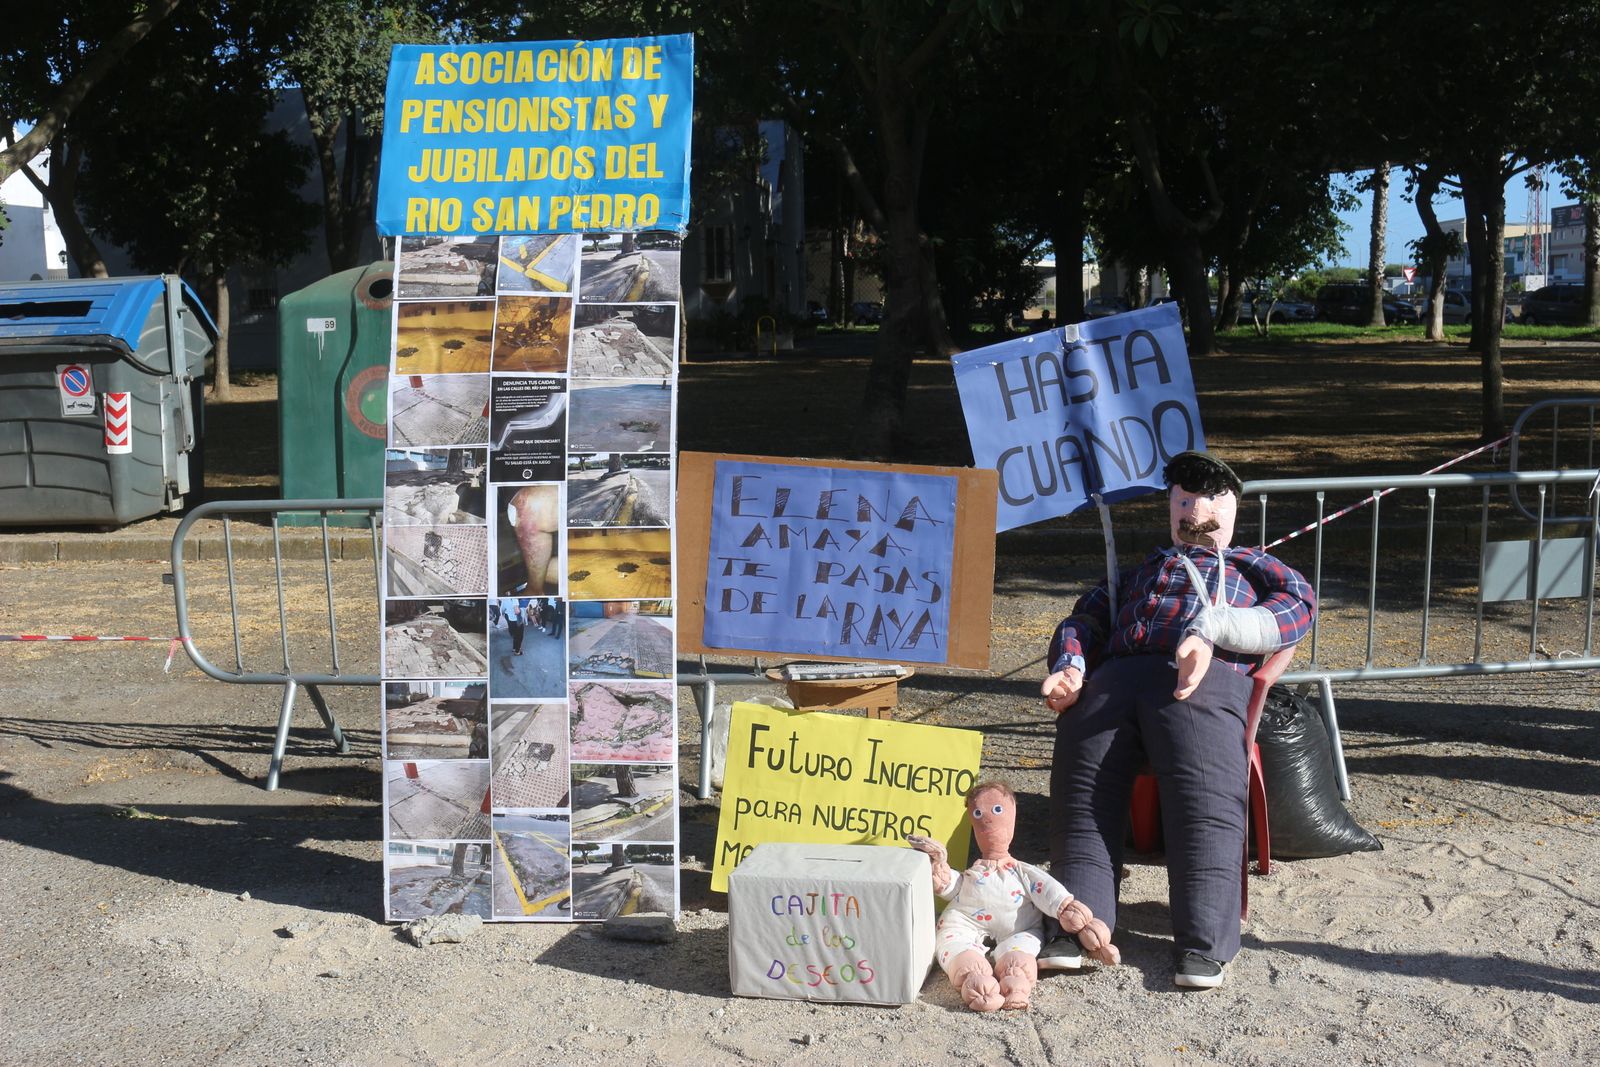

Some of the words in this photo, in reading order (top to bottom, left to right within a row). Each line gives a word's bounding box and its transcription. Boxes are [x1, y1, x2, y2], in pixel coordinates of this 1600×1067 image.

[414, 41, 612, 85] ASOCIACIÓN
[621, 45, 662, 81] DE
[399, 94, 637, 134] PENSIONISTAS
[648, 94, 669, 128] Y
[408, 145, 596, 183] JUBILADOS
[604, 142, 665, 180] DEL
[405, 197, 463, 233] RIO
[471, 195, 540, 232] SAN
[548, 193, 660, 230] PEDRO
[994, 329, 1172, 422] HASTA
[995, 400, 1195, 507] CUÁNDO
[731, 475, 944, 532] ELENA
[739, 522, 913, 558] AMAYA
[717, 557, 778, 579] TE
[812, 561, 942, 604] PASAS
[719, 588, 779, 614] DE
[839, 601, 940, 652] RAYA
[812, 804, 932, 840] NUESTROS
[772, 893, 860, 919] CAJITA
[786, 926, 809, 946] de
[766, 959, 874, 986] DESEOS
